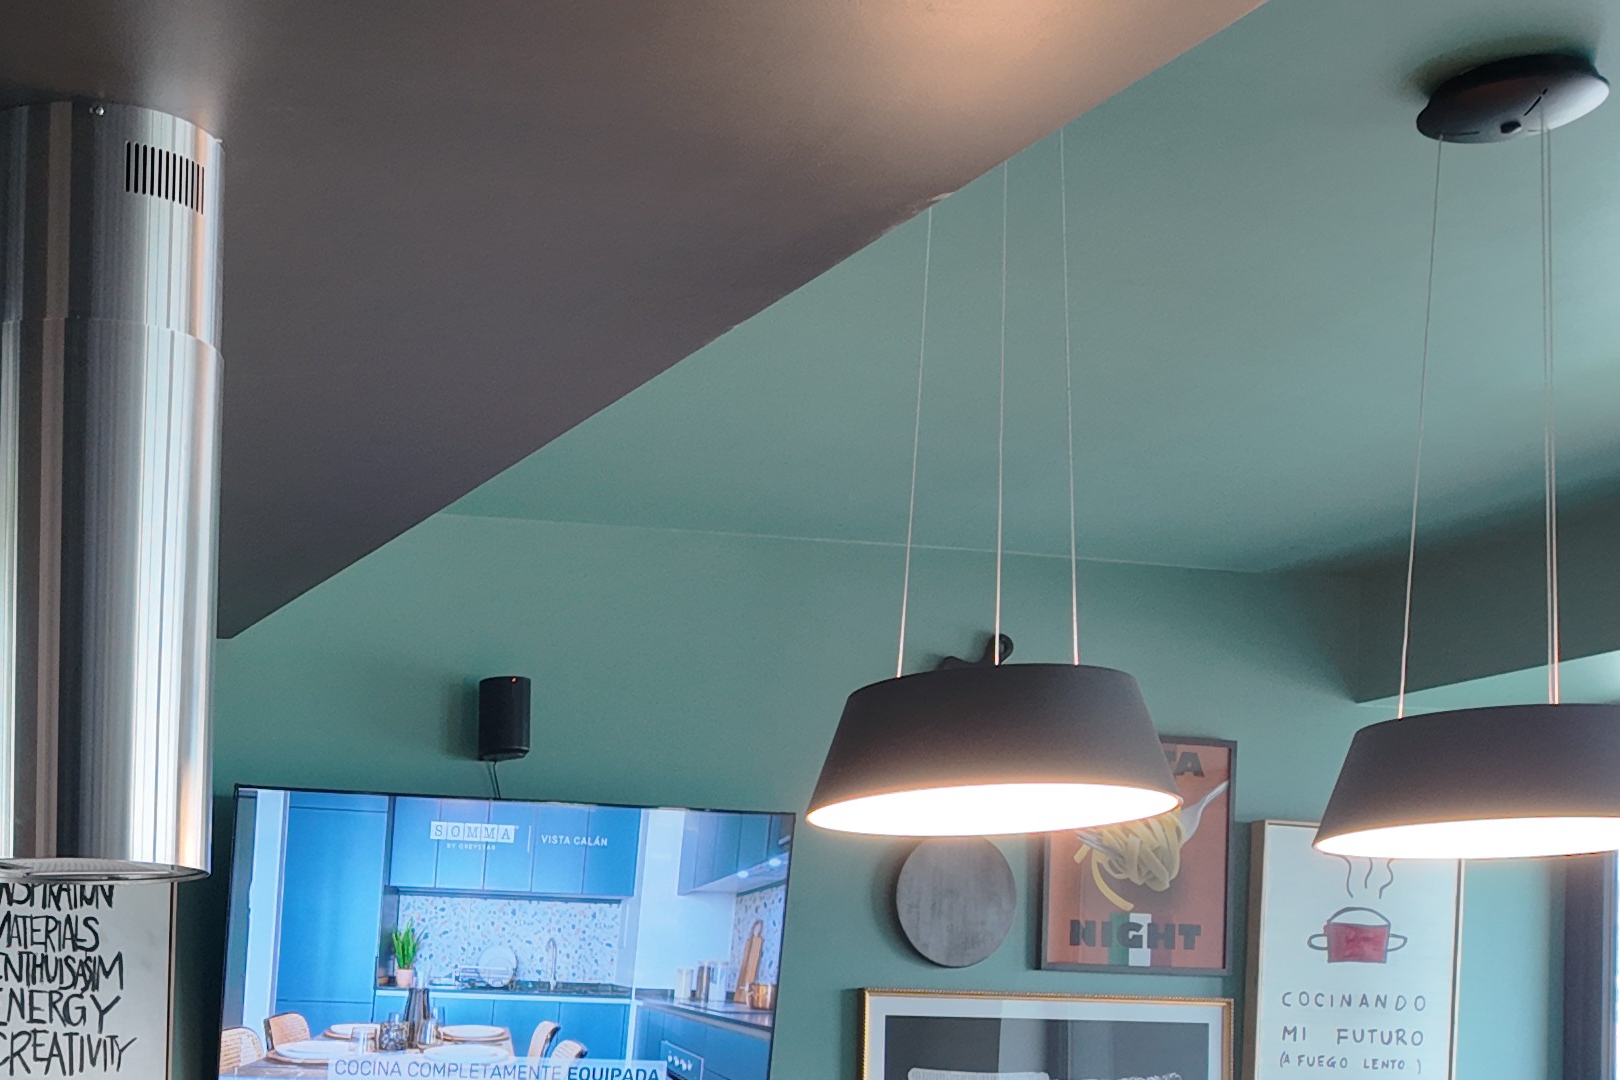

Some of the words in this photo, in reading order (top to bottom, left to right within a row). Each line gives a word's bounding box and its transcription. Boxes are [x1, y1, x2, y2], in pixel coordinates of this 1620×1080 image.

[433, 823, 512, 842] SOMMA
[541, 834, 571, 845] VISTA
[573, 835, 608, 847] CALÁN
[1069, 919, 1202, 950] NIGHT
[1281, 990, 1426, 1012] COCINANDO
[1281, 1025, 1307, 1042] MI
[1336, 1028, 1424, 1046] FUTURO
[334, 1059, 402, 1078] COCINA
[1280, 1051, 1291, 1068] (A
[1297, 1054, 1348, 1069] FUEGO
